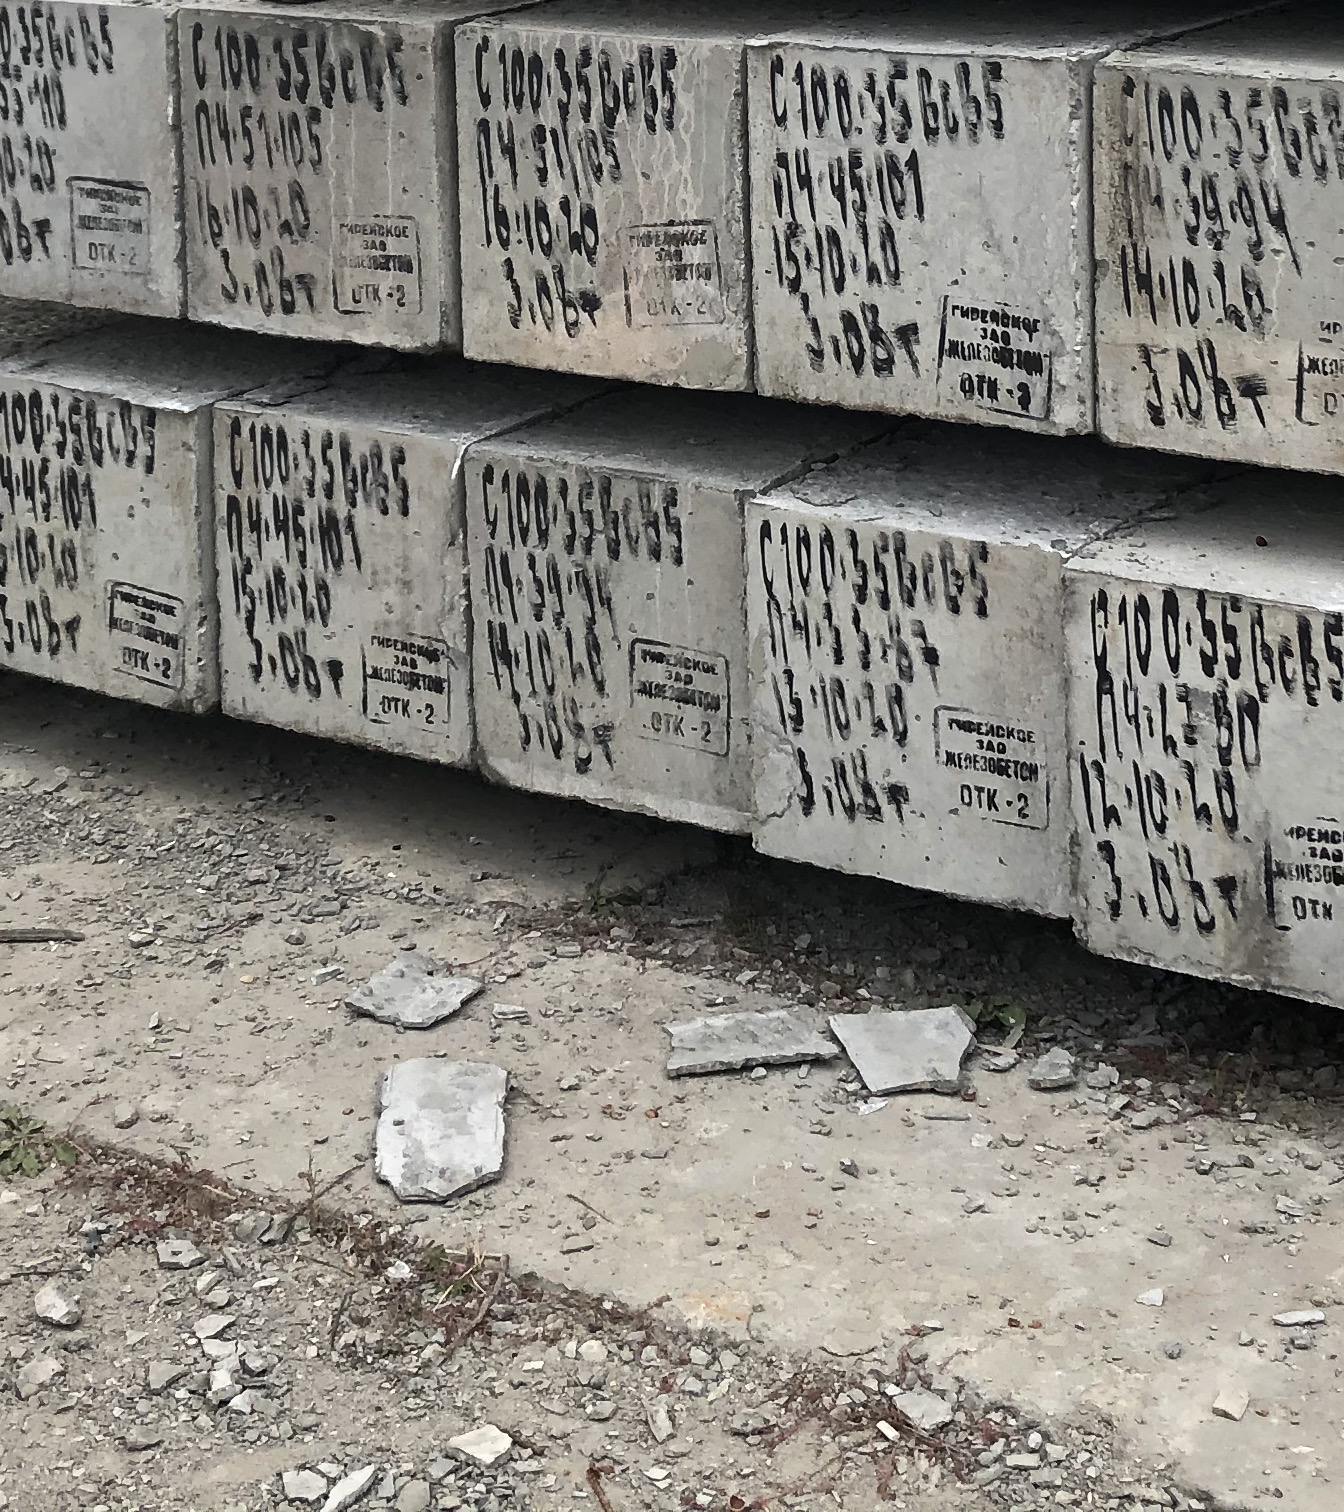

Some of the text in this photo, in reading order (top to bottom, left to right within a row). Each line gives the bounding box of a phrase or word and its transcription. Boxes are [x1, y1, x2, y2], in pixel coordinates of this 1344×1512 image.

[362, 239, 387, 252] ЗАО
[393, 654, 419, 670] ЗАО
[664, 669, 694, 686] ЗАО
[975, 738, 1007, 755] ЗАО
